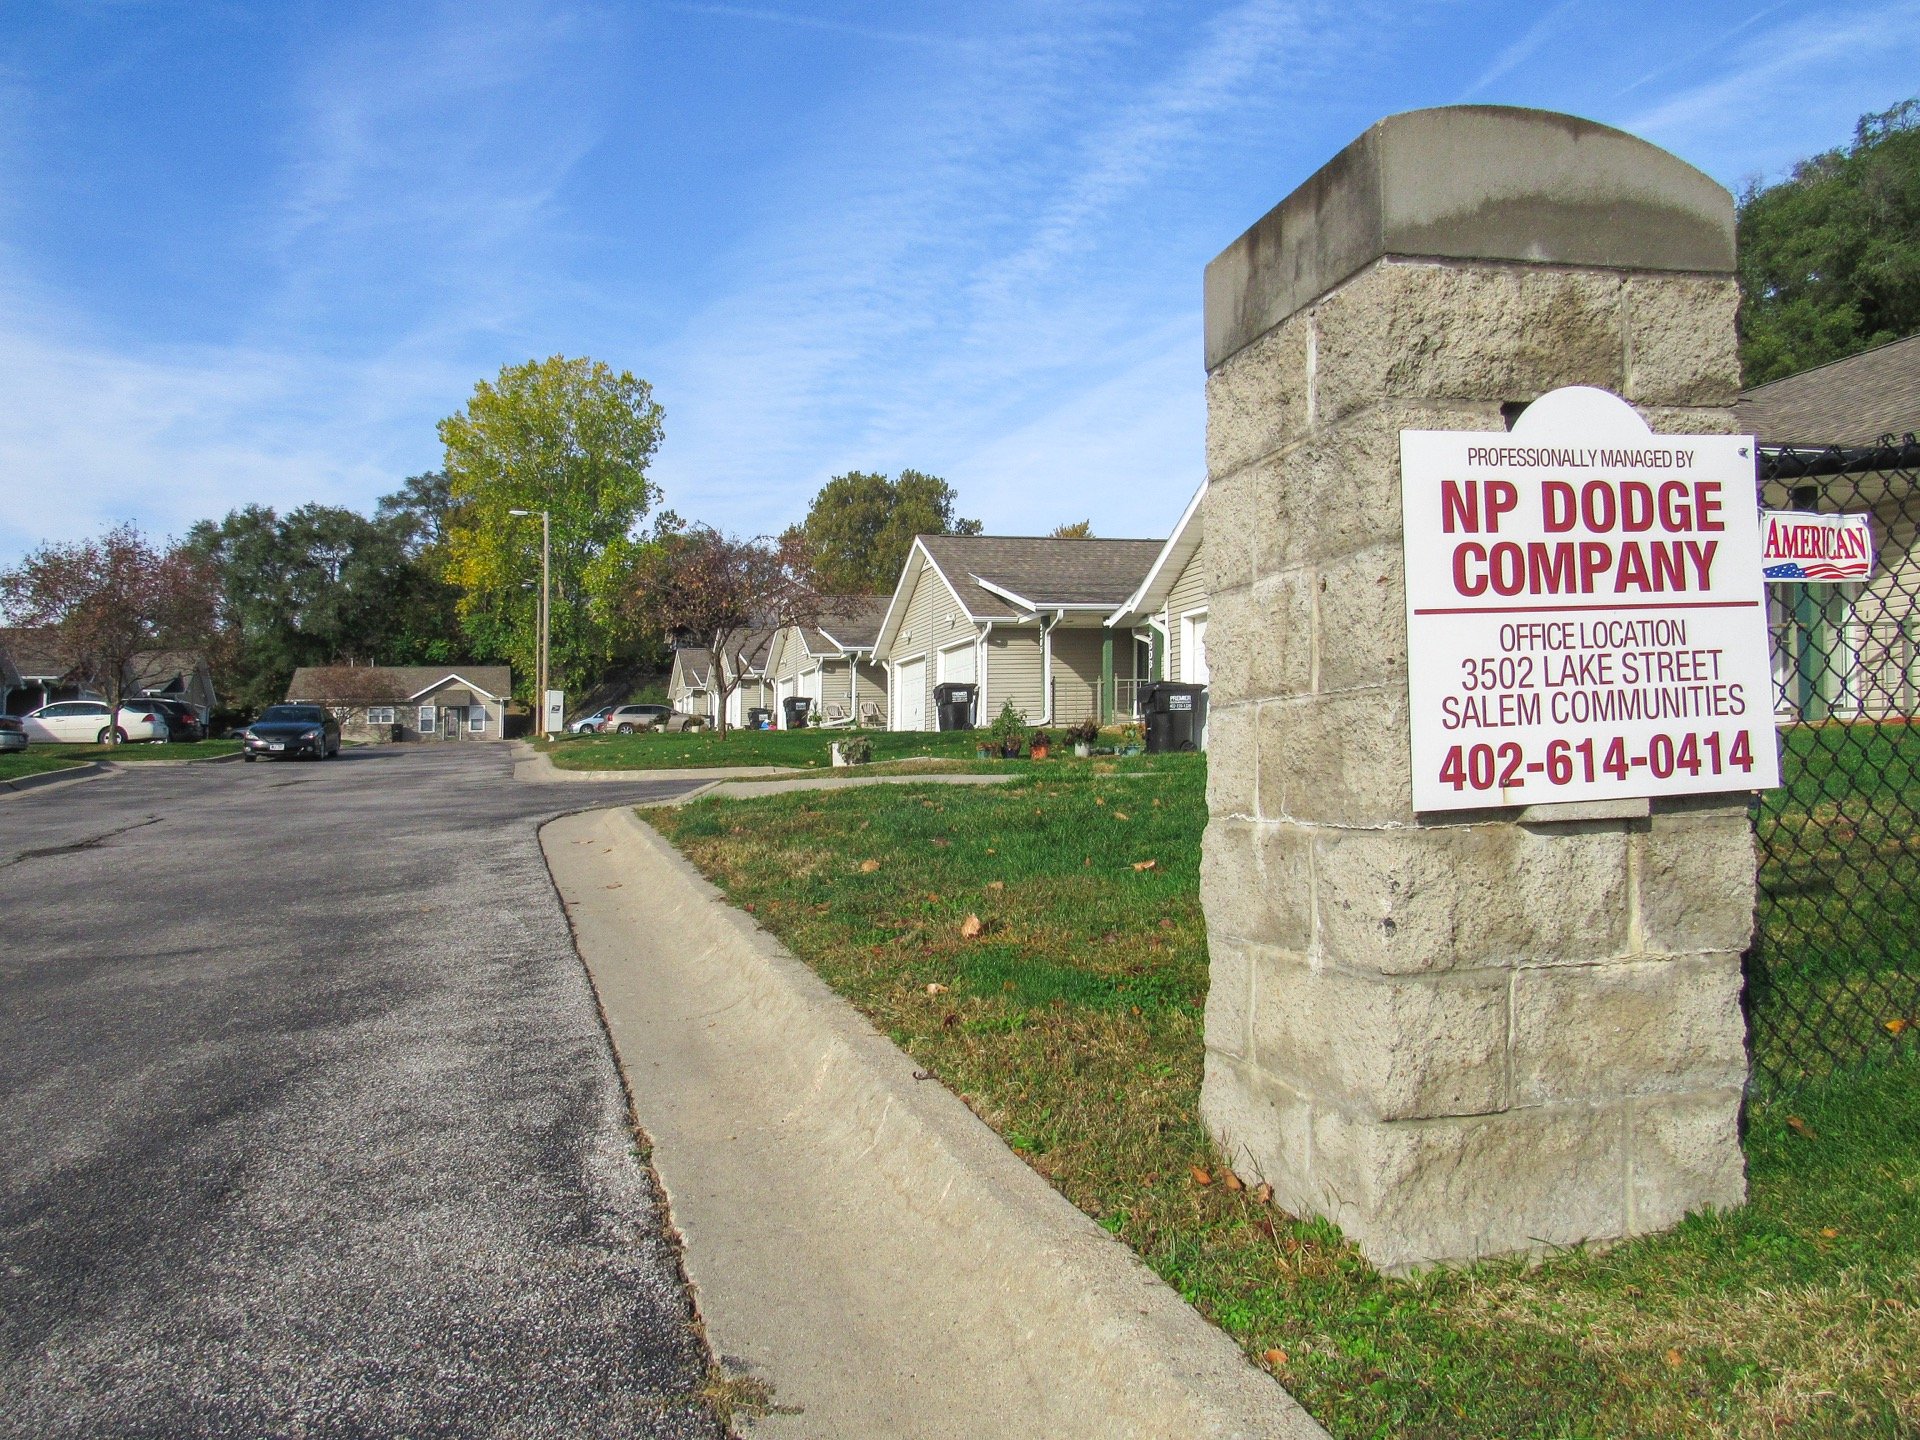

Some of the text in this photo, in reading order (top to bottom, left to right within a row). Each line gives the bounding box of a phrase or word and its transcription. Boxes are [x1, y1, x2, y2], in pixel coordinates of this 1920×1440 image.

[1468, 448, 1694, 468] PROFESSIONALLY MANAGED BY
[1441, 480, 1725, 534] NP DODGE
[1764, 517, 1866, 560] AMERICAN
[1453, 541, 1718, 597] COMPANY
[1500, 620, 1687, 653] OFFICE LOCATION
[1462, 650, 1722, 692] 3502 LAKE STREET
[1442, 684, 1745, 729] SALEM COMMUNITIES
[1439, 730, 1754, 792] 402-614-0414
